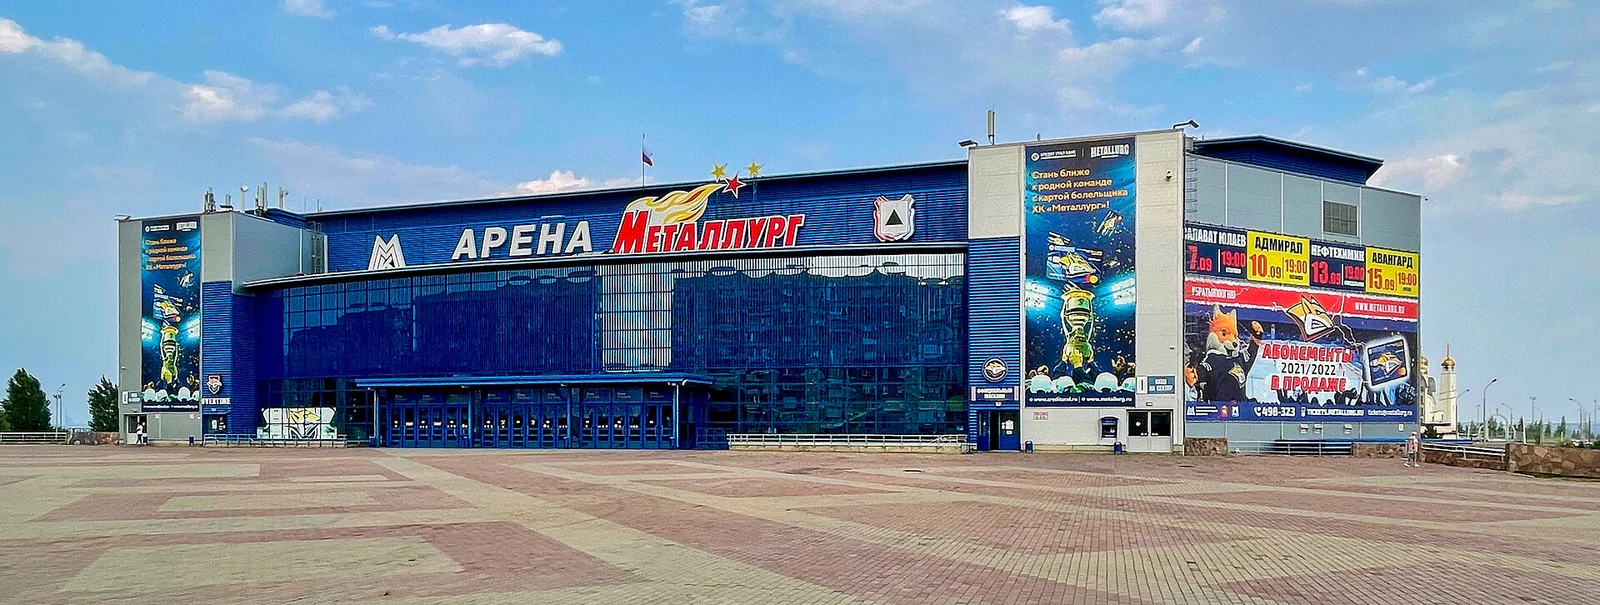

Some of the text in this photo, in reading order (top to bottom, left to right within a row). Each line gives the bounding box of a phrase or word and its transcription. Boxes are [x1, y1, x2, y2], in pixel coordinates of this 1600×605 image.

[1032, 171, 1059, 179] Стань
[1039, 181, 1072, 191] родной
[1073, 179, 1112, 187] команде
[1039, 193, 1070, 203] картой
[1071, 189, 1128, 199] болельщика
[1032, 205, 1045, 213] ХК
[452, 221, 593, 260] АРЕНА
[1218, 231, 1247, 248] ЮЛАЕВ
[1255, 236, 1303, 254] АДМИРАЛ
[1187, 245, 1246, 271] 7.09 19:00
[1311, 244, 1365, 261] НЕФТЕХИМИК
[1372, 252, 1413, 269] АВАНГАРД
[1249, 254, 1307, 279] 10.09 19:00
[1311, 261, 1365, 285] 13.09 19:00
[1367, 268, 1417, 291] 15.09 19:00
[1262, 344, 1353, 363] АБОНЕМЕНТЫ
[1281, 362, 1336, 376] 2021/2022
[1271, 375, 1346, 394] В ПРОДАЖЕ
[1261, 406, 1296, 417] 498-323
